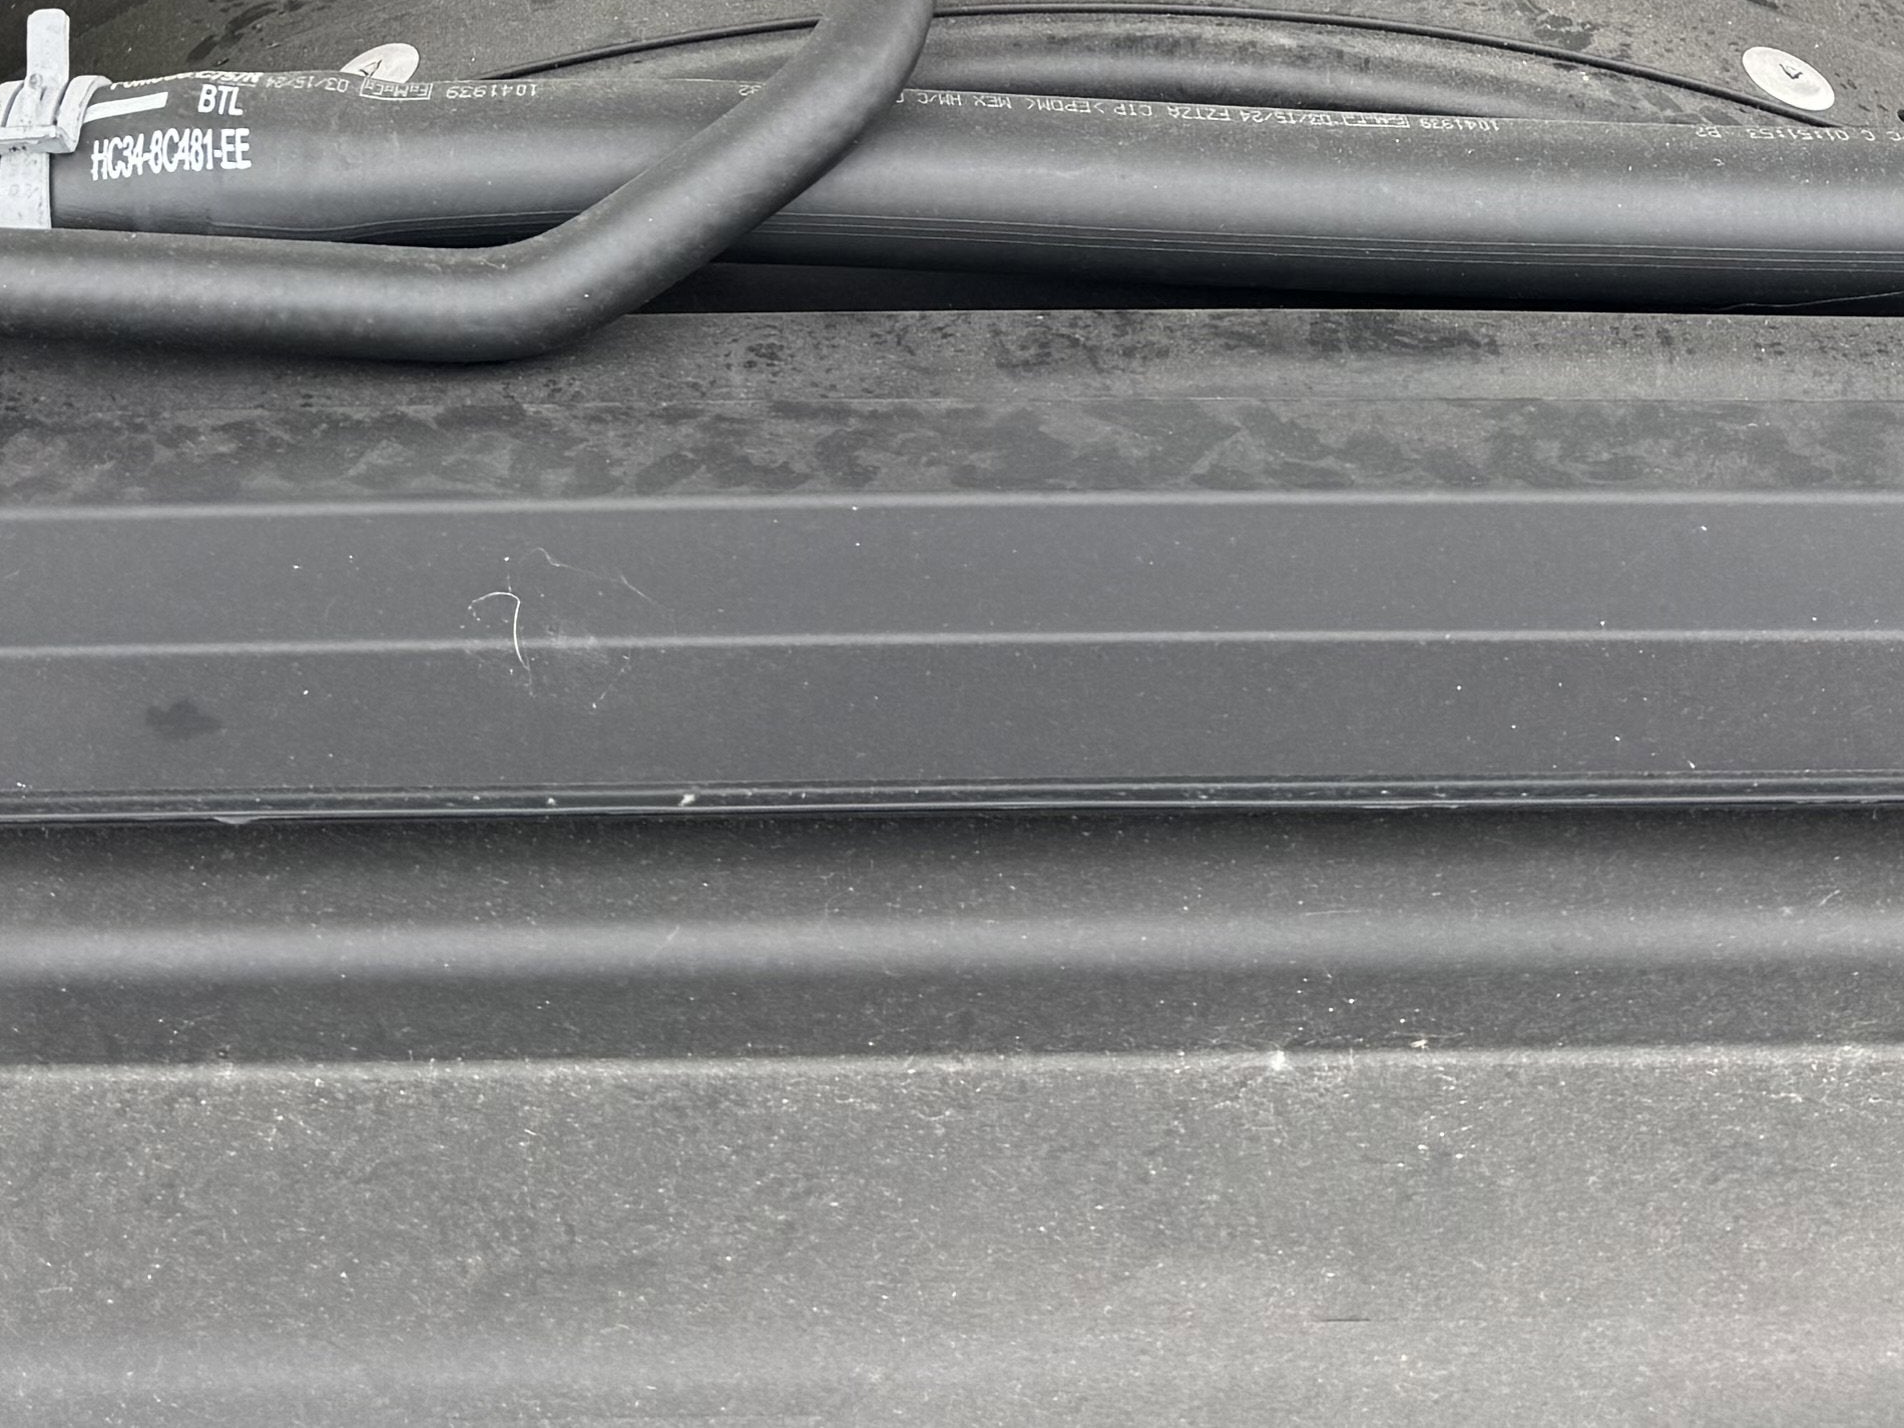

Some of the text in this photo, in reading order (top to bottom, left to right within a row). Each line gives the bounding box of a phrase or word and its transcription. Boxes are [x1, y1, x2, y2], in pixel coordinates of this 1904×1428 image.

[265, 75, 349, 93] 03/15/24
[446, 83, 539, 99] 1041939
[197, 83, 245, 116] BTL
[972, 95, 1012, 110] MEX
[1239, 108, 1334, 126] 03/15/24
[89, 126, 253, 181] HC34-8C481-EE
